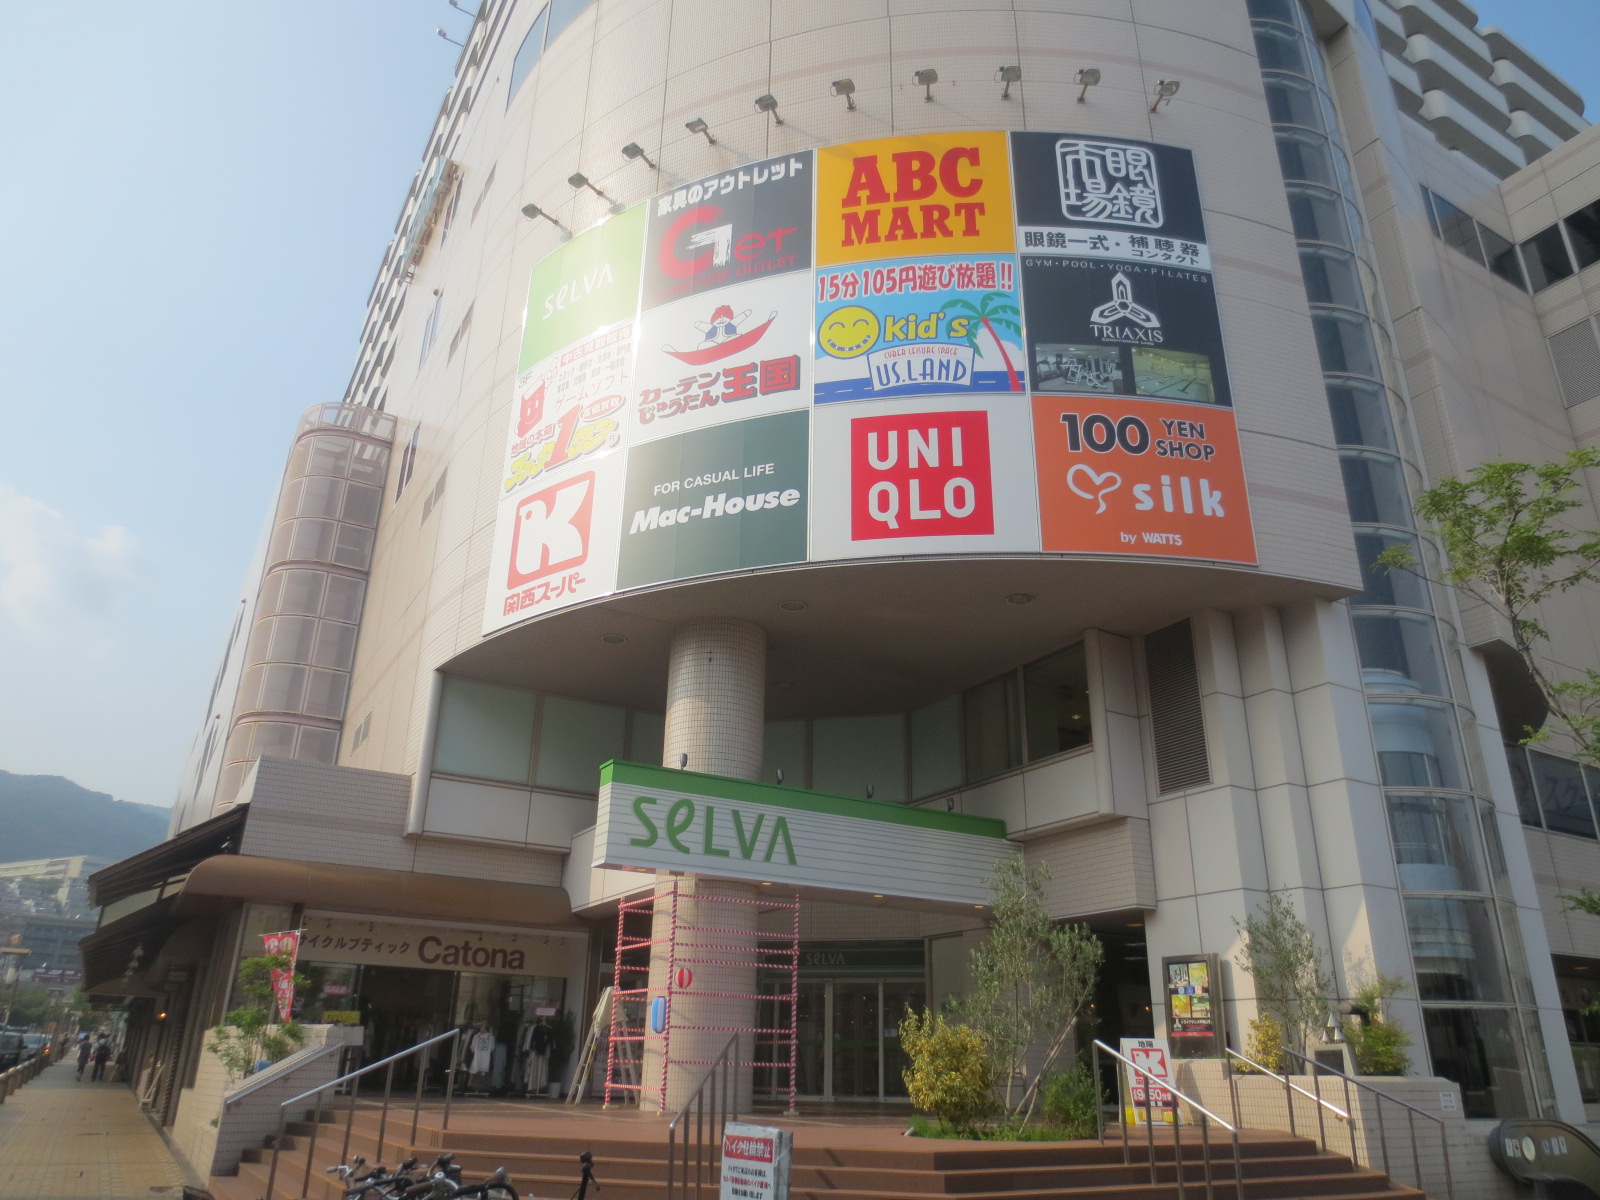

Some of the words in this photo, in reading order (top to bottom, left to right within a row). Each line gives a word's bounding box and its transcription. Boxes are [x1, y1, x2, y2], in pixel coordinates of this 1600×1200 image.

[657, 157, 803, 217] 家具のアウトレット
[841, 147, 983, 209] ABC
[841, 202, 986, 247] MART
[736, 253, 797, 278] OUTLET
[1131, 249, 1199, 266] コンタクト
[884, 312, 971, 342] Kid's
[1089, 324, 1163, 343] TRIAXIS
[638, 371, 721, 407] カーテン
[721, 354, 801, 404] 王国
[638, 390, 721, 425] じゅうたん
[1060, 413, 1150, 456] 100
[1160, 417, 1206, 441] YEN
[1155, 439, 1216, 462] SHOP
[653, 481, 680, 497] FOR
[684, 469, 740, 490] CASUAL
[744, 463, 775, 479] LIFE
[1133, 474, 1225, 518] silk
[629, 488, 801, 535] Mac-House
[1120, 531, 1137, 546] by
[1142, 531, 1183, 546] WATTS
[503, 572, 586, 617] 関西スーパー
[418, 935, 525, 970] Catona
